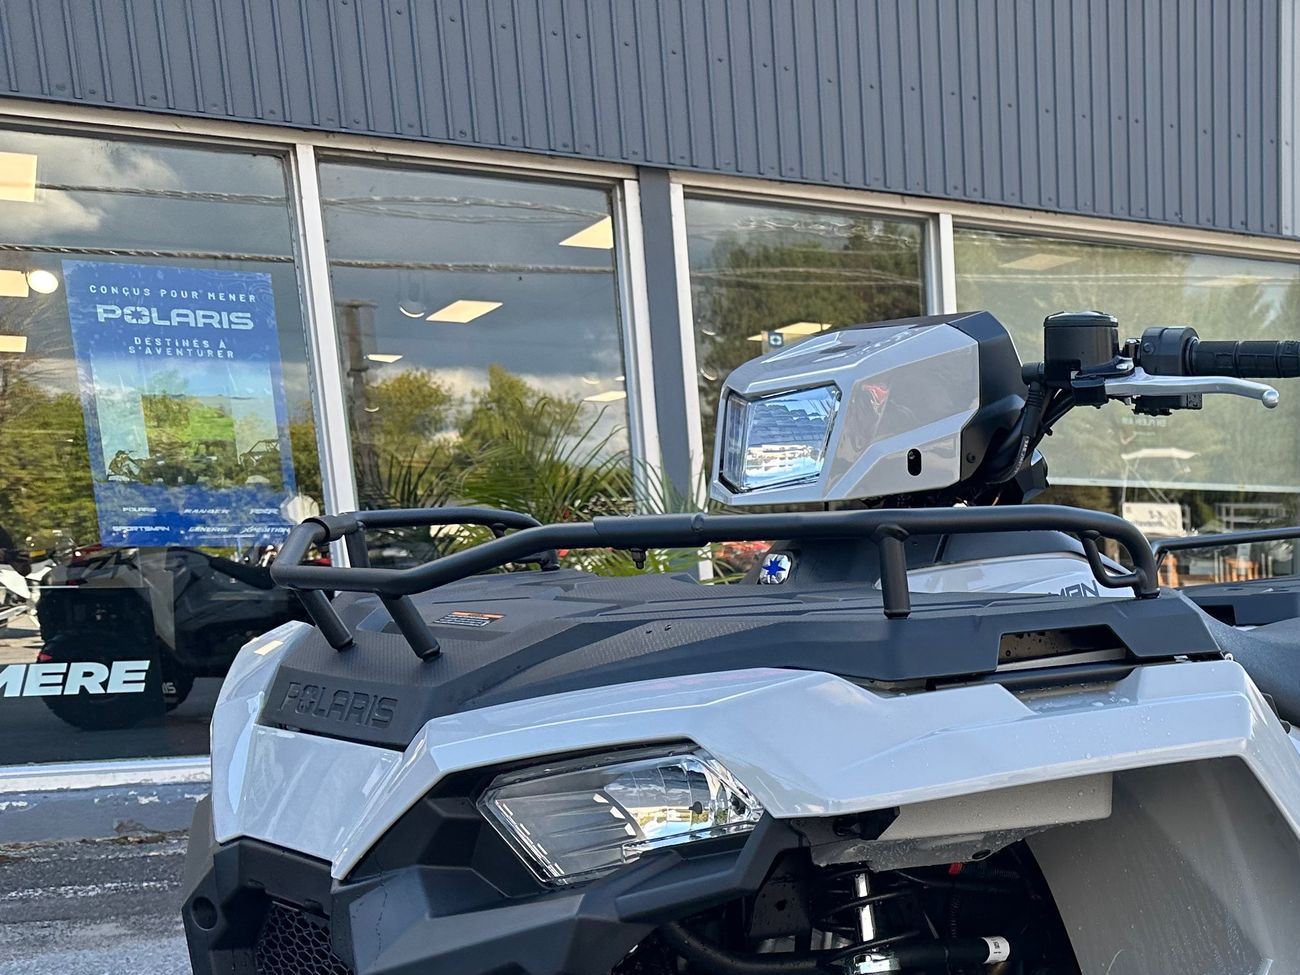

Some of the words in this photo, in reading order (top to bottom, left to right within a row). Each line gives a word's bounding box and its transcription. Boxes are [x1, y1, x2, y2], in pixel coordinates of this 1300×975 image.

[89, 284, 151, 296] CONÇUS
[160, 289, 199, 300] POUR
[207, 292, 256, 303] MENER
[96, 304, 254, 330] POLARIS
[128, 345, 235, 359] S'AVENTURER
[277, 681, 399, 729] POLARIS
